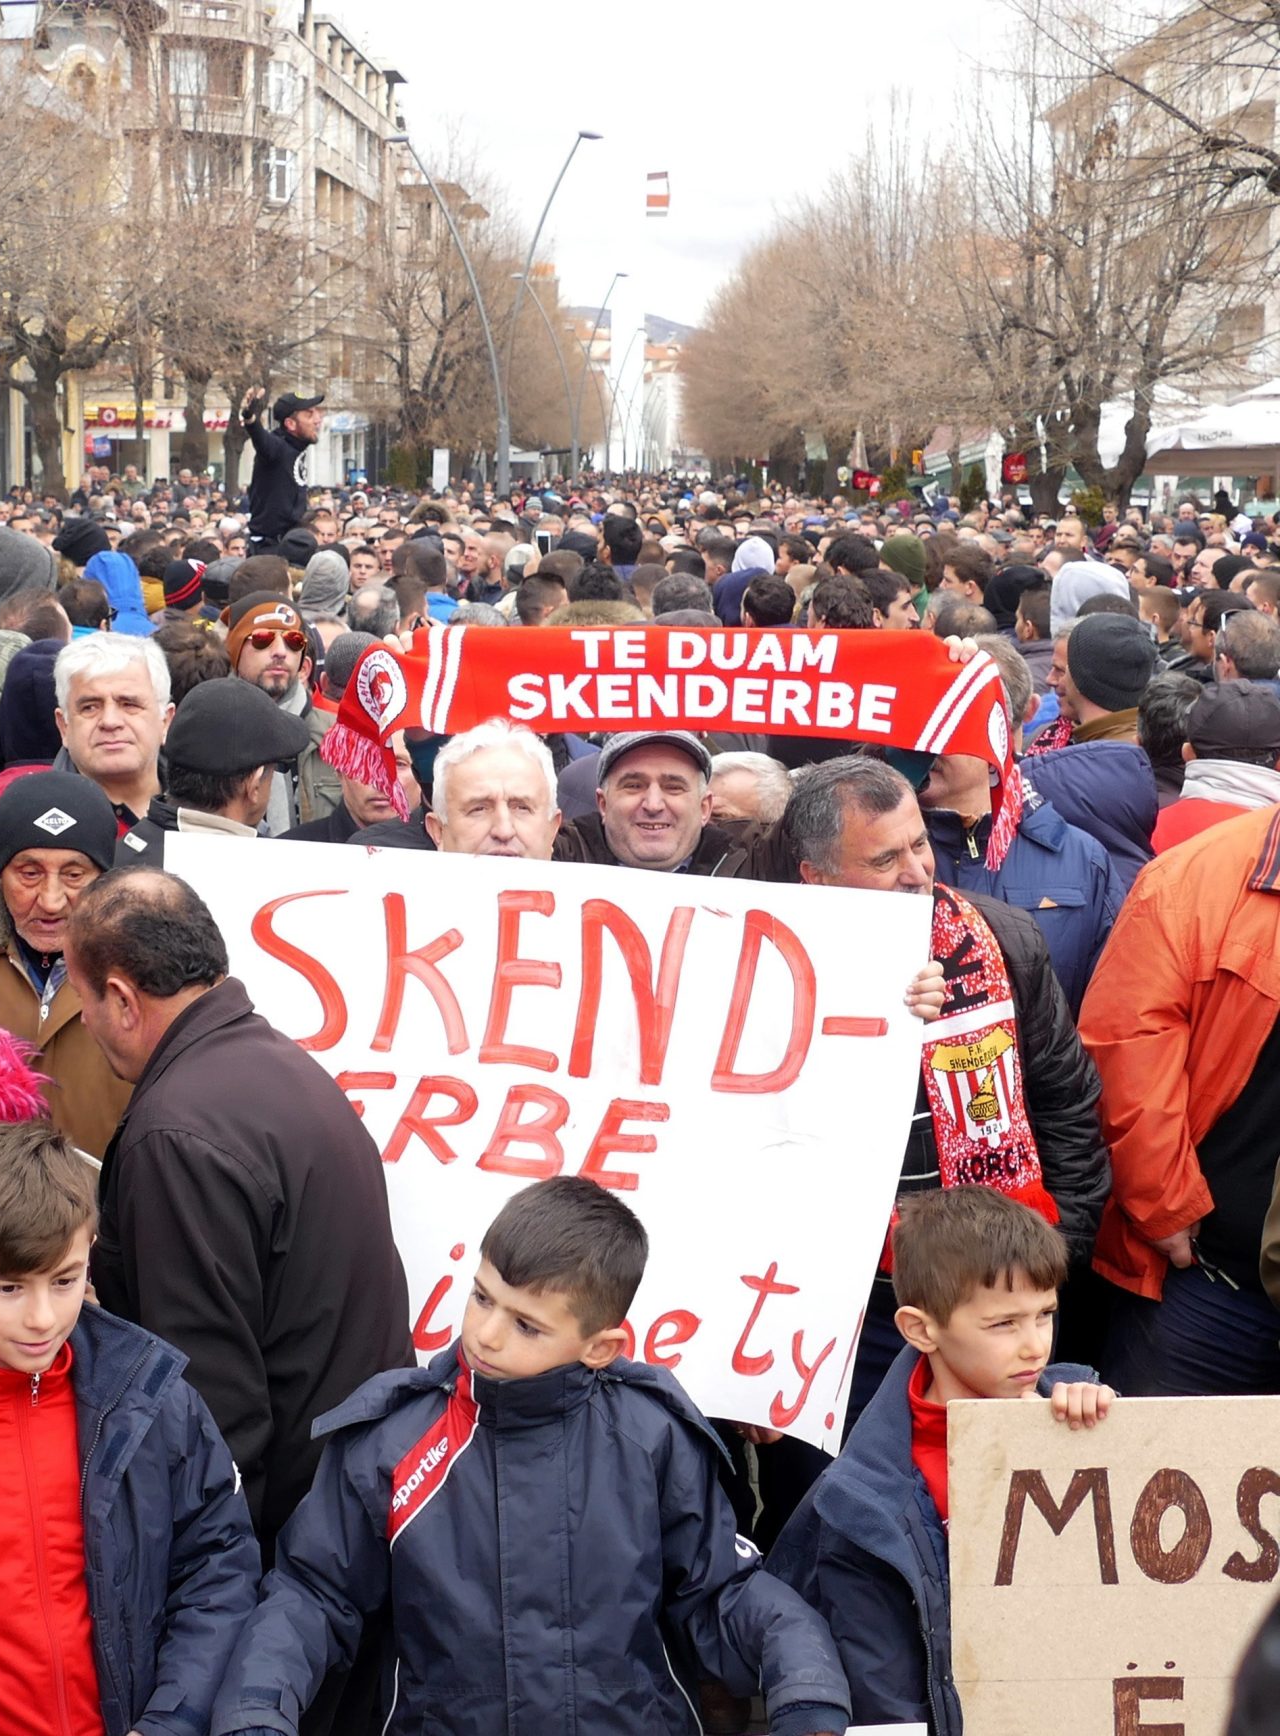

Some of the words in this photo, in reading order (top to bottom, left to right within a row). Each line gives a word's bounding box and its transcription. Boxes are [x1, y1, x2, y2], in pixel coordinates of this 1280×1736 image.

[571, 630, 647, 671] TE
[668, 632, 839, 674] DUAM
[508, 673, 897, 734] SKENDERBE
[251, 889, 889, 1094] SKEND-
[980, 1122, 1003, 1135] 1921
[994, 1466, 1280, 1587] MOS
